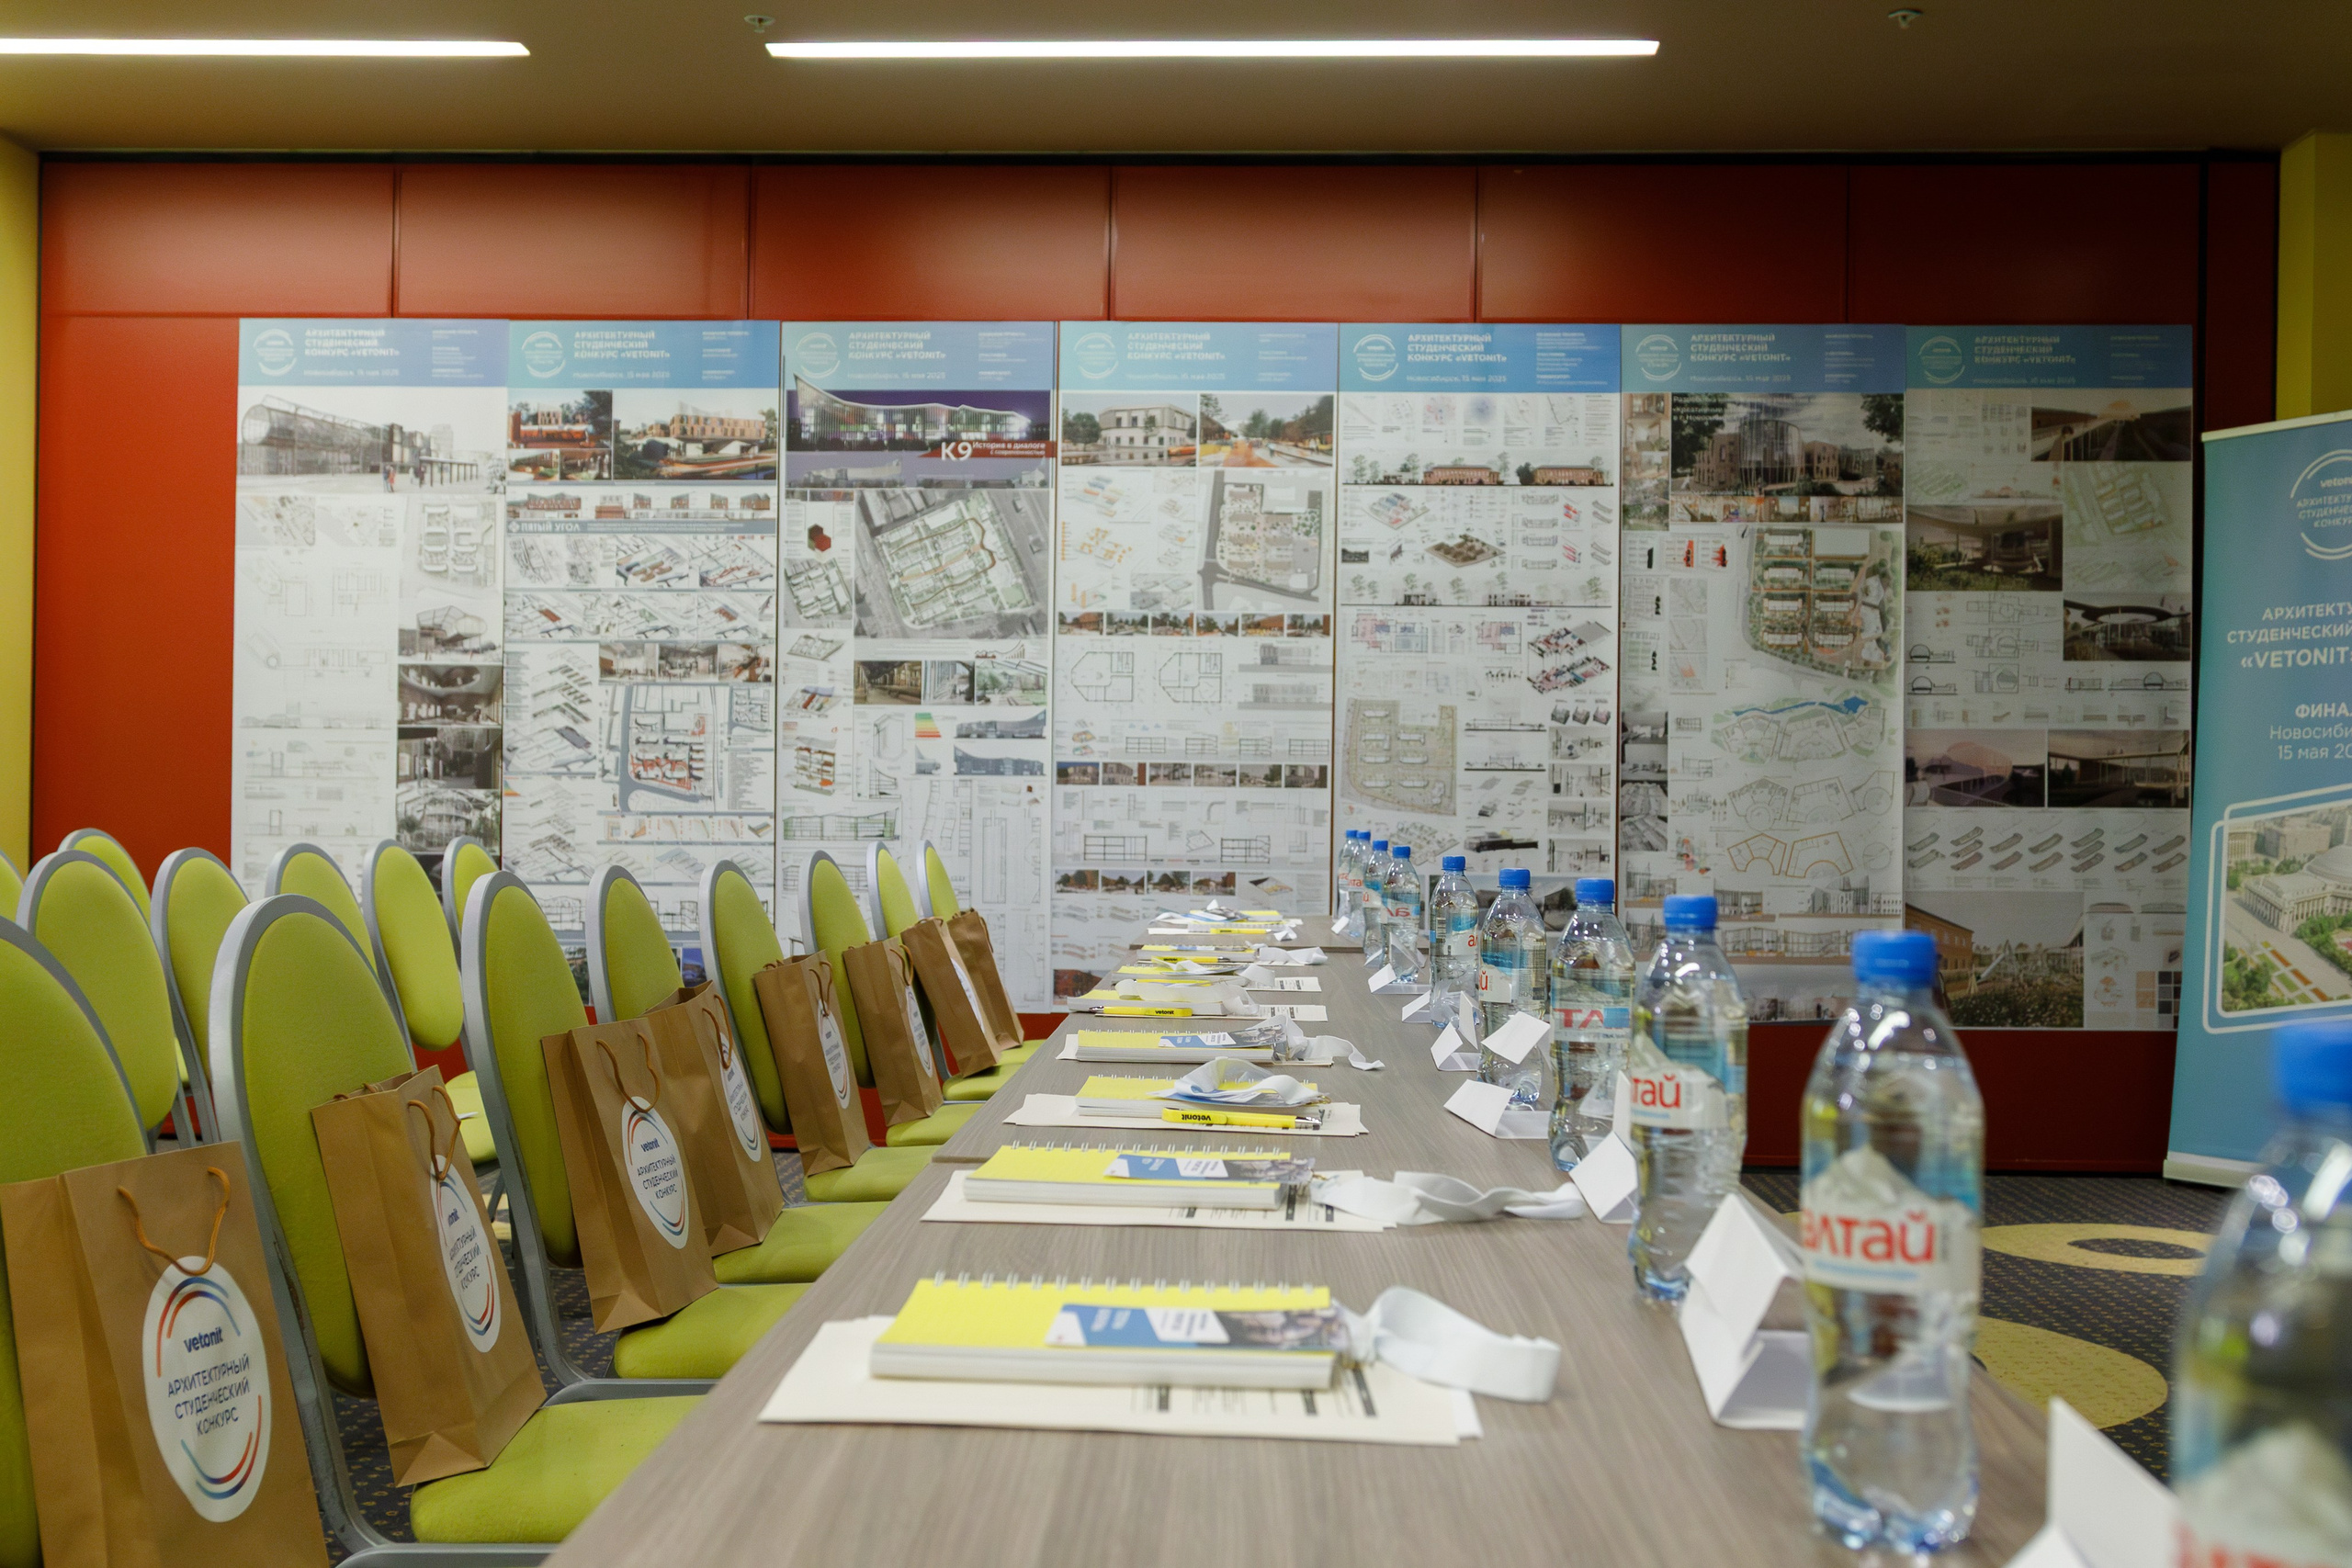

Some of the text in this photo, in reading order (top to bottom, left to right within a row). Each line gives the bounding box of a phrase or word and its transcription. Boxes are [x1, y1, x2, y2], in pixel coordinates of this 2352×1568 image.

[1408, 333, 1492, 343] АРХИТЕКТУРНЫЙ
[1408, 344, 1485, 352] СТУДЕНЧЕСКИЙ
[1408, 354, 1508, 362] КОНКУРС «VETONIT»
[972, 441, 1005, 449] История
[554, 523, 581, 532] УГОЛ
[2241, 646, 2352, 669] «VETONIT
[2295, 701, 2352, 718] ФИНА
[2278, 745, 2293, 761] 15
[2297, 746, 2329, 760] мая
[1182, 1113, 1211, 1122] vetonit
[184, 1326, 223, 1353] vetonit
[168, 1353, 250, 1398] АРХИТЕКТУРНЫЙ
[175, 1376, 250, 1420] СТУДЕНЧЕСКИЙ
[196, 1406, 240, 1436] КОНКУРС
